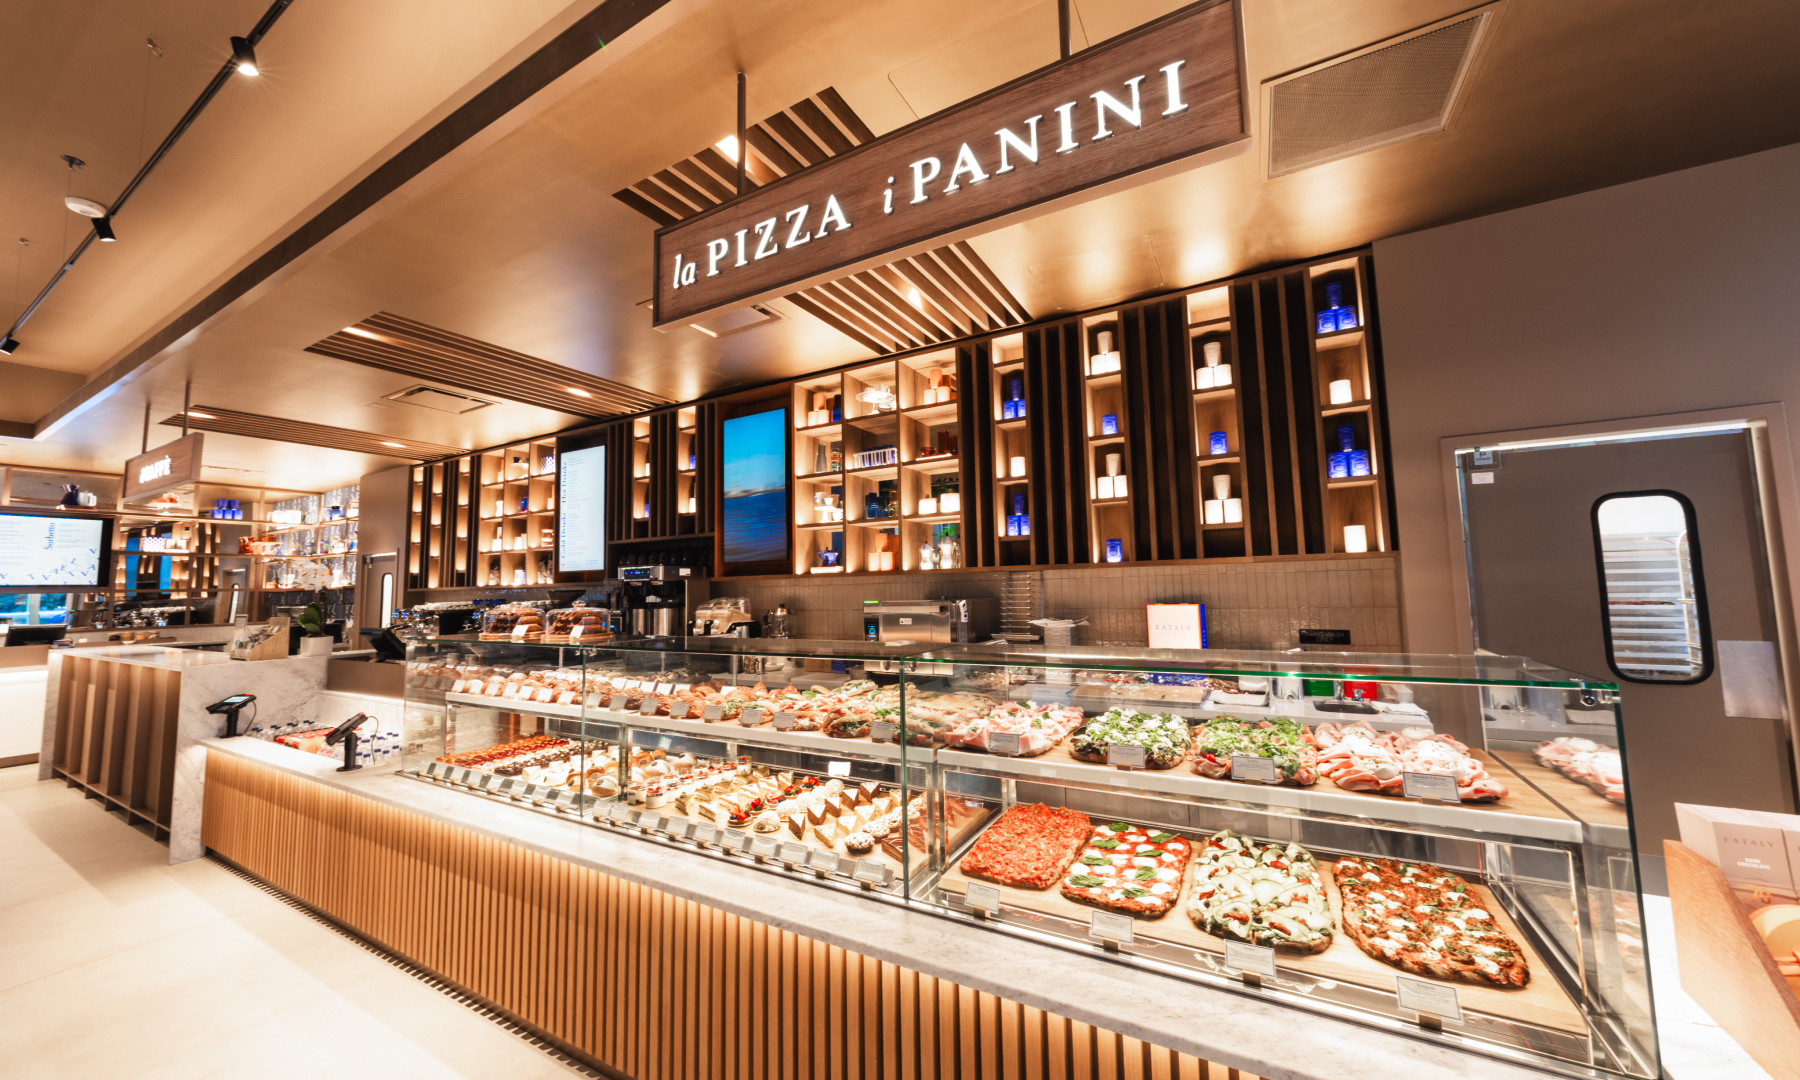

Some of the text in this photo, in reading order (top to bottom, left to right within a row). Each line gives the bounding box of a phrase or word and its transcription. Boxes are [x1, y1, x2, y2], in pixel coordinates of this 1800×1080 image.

[673, 60, 1188, 289] la PIZZA i PANINI
[43, 522, 55, 550] Sorbetto
[1723, 836, 1775, 848] EATALY
[1736, 861, 1771, 870] CHOCOLATE
